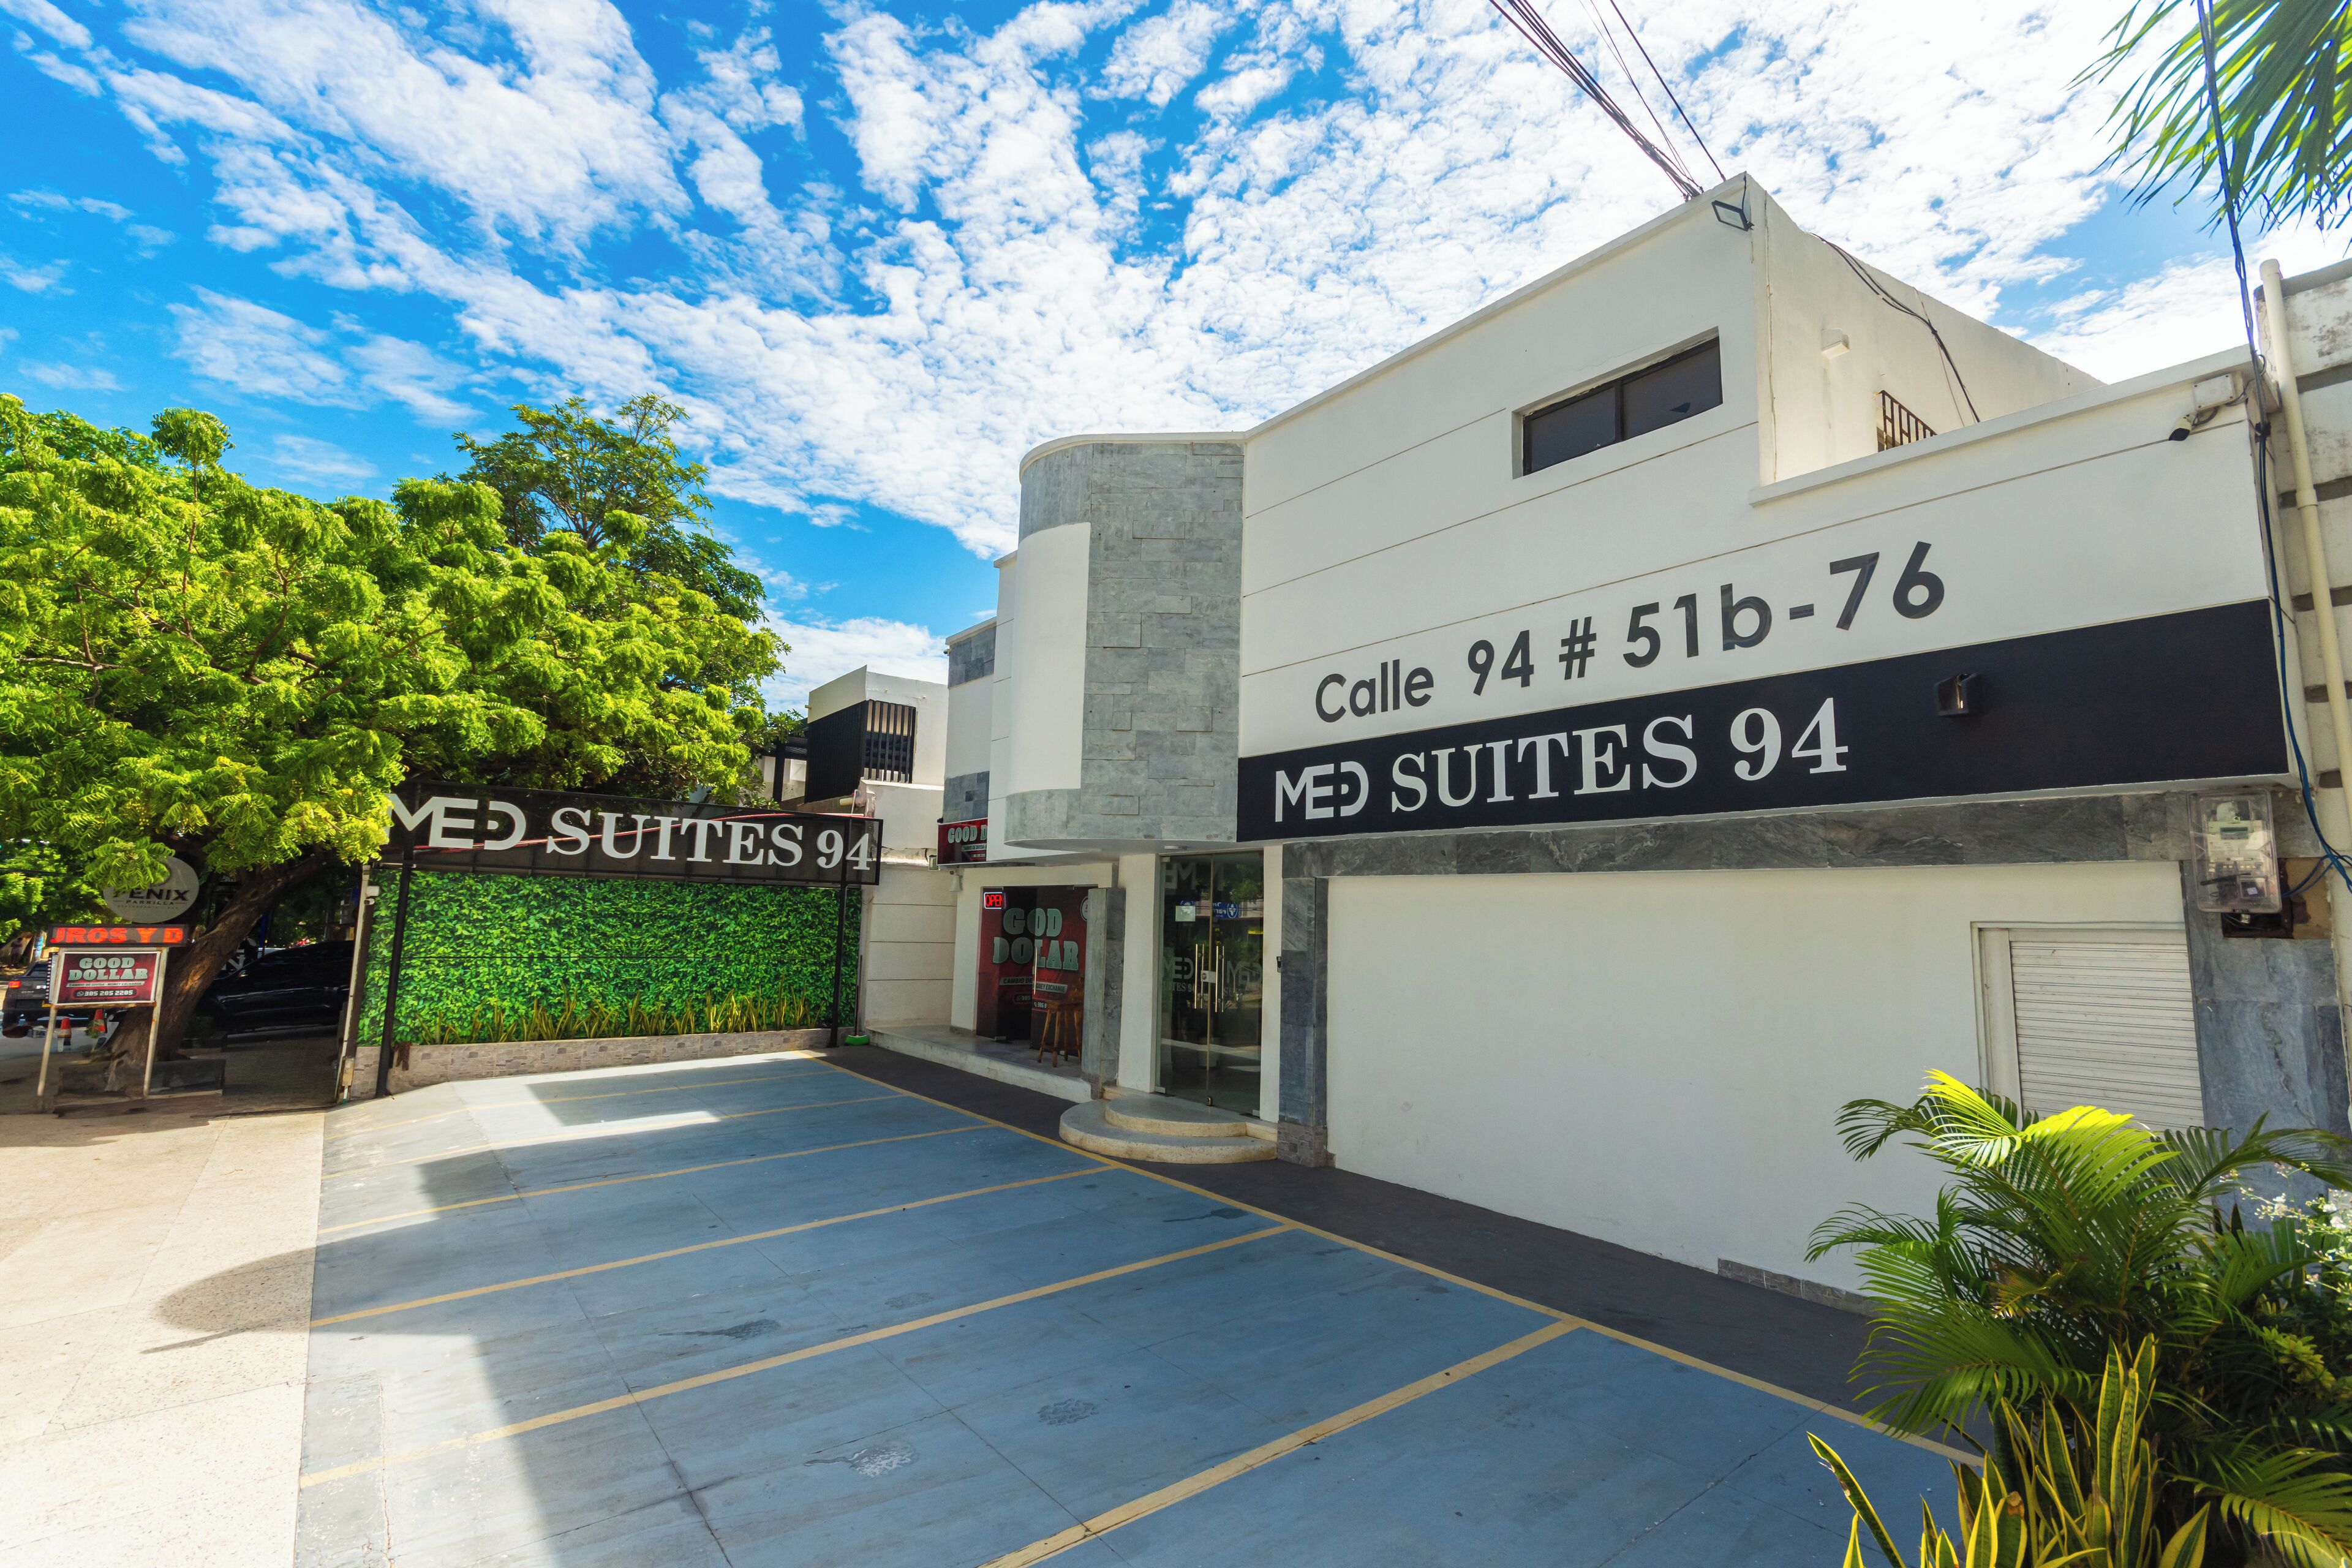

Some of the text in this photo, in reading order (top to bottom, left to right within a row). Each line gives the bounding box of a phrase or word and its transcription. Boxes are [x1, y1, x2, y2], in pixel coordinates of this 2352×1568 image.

[1316, 659, 1434, 723] Calle
[1468, 630, 1534, 696] 94
[1559, 616, 1597, 680] #
[1275, 697, 1849, 823] MED SUITES 94
[383, 793, 873, 870] MED SUITES 94
[948, 826, 978, 843] GOOD
[136, 927, 157, 943] Y
[163, 927, 184, 943] D
[79, 957, 135, 969] GOOD
[68, 968, 148, 981] DOLLAR
[1046, 984, 1065, 992] EXCHANGE
